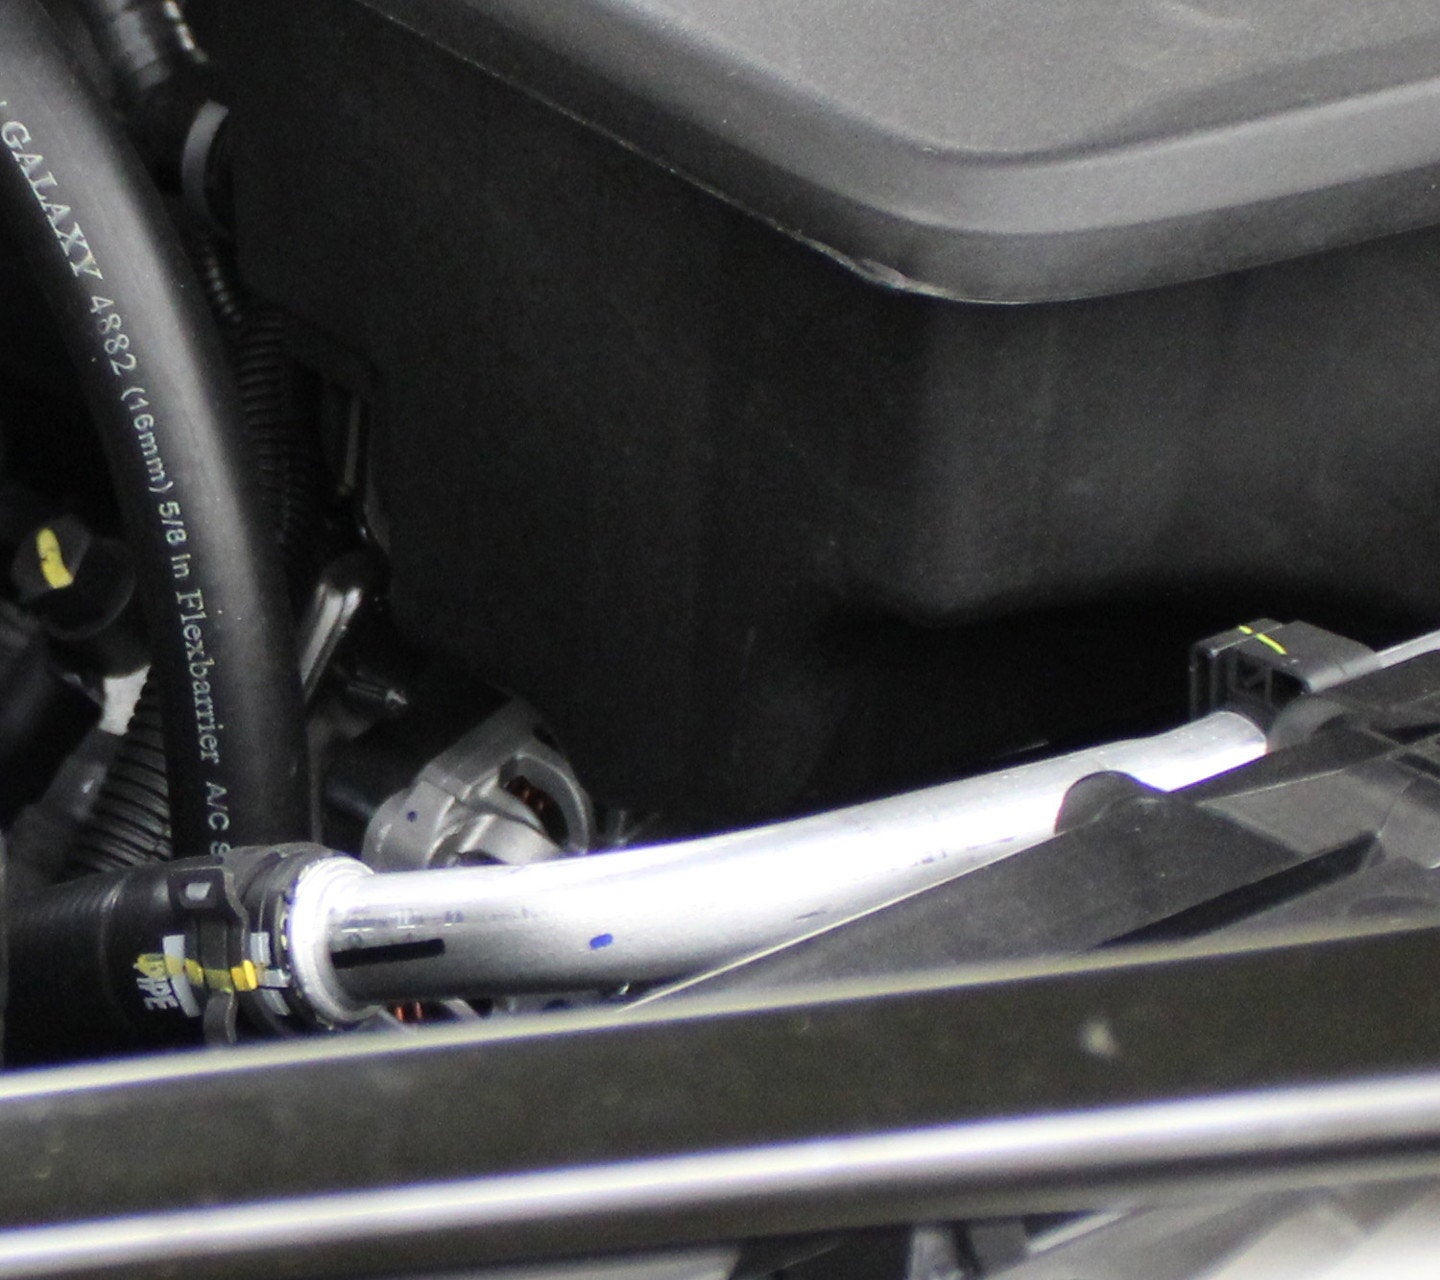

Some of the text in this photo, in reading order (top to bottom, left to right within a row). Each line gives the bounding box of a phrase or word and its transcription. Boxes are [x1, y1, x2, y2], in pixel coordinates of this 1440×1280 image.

[0, 120, 103, 280] GALAXY
[89, 295, 137, 376] 4882
[120, 386, 174, 494] (16mm)
[159, 500, 188, 546] 5/8
[175, 588, 224, 765] Flexbarrier
[205, 780, 230, 832] A/C
